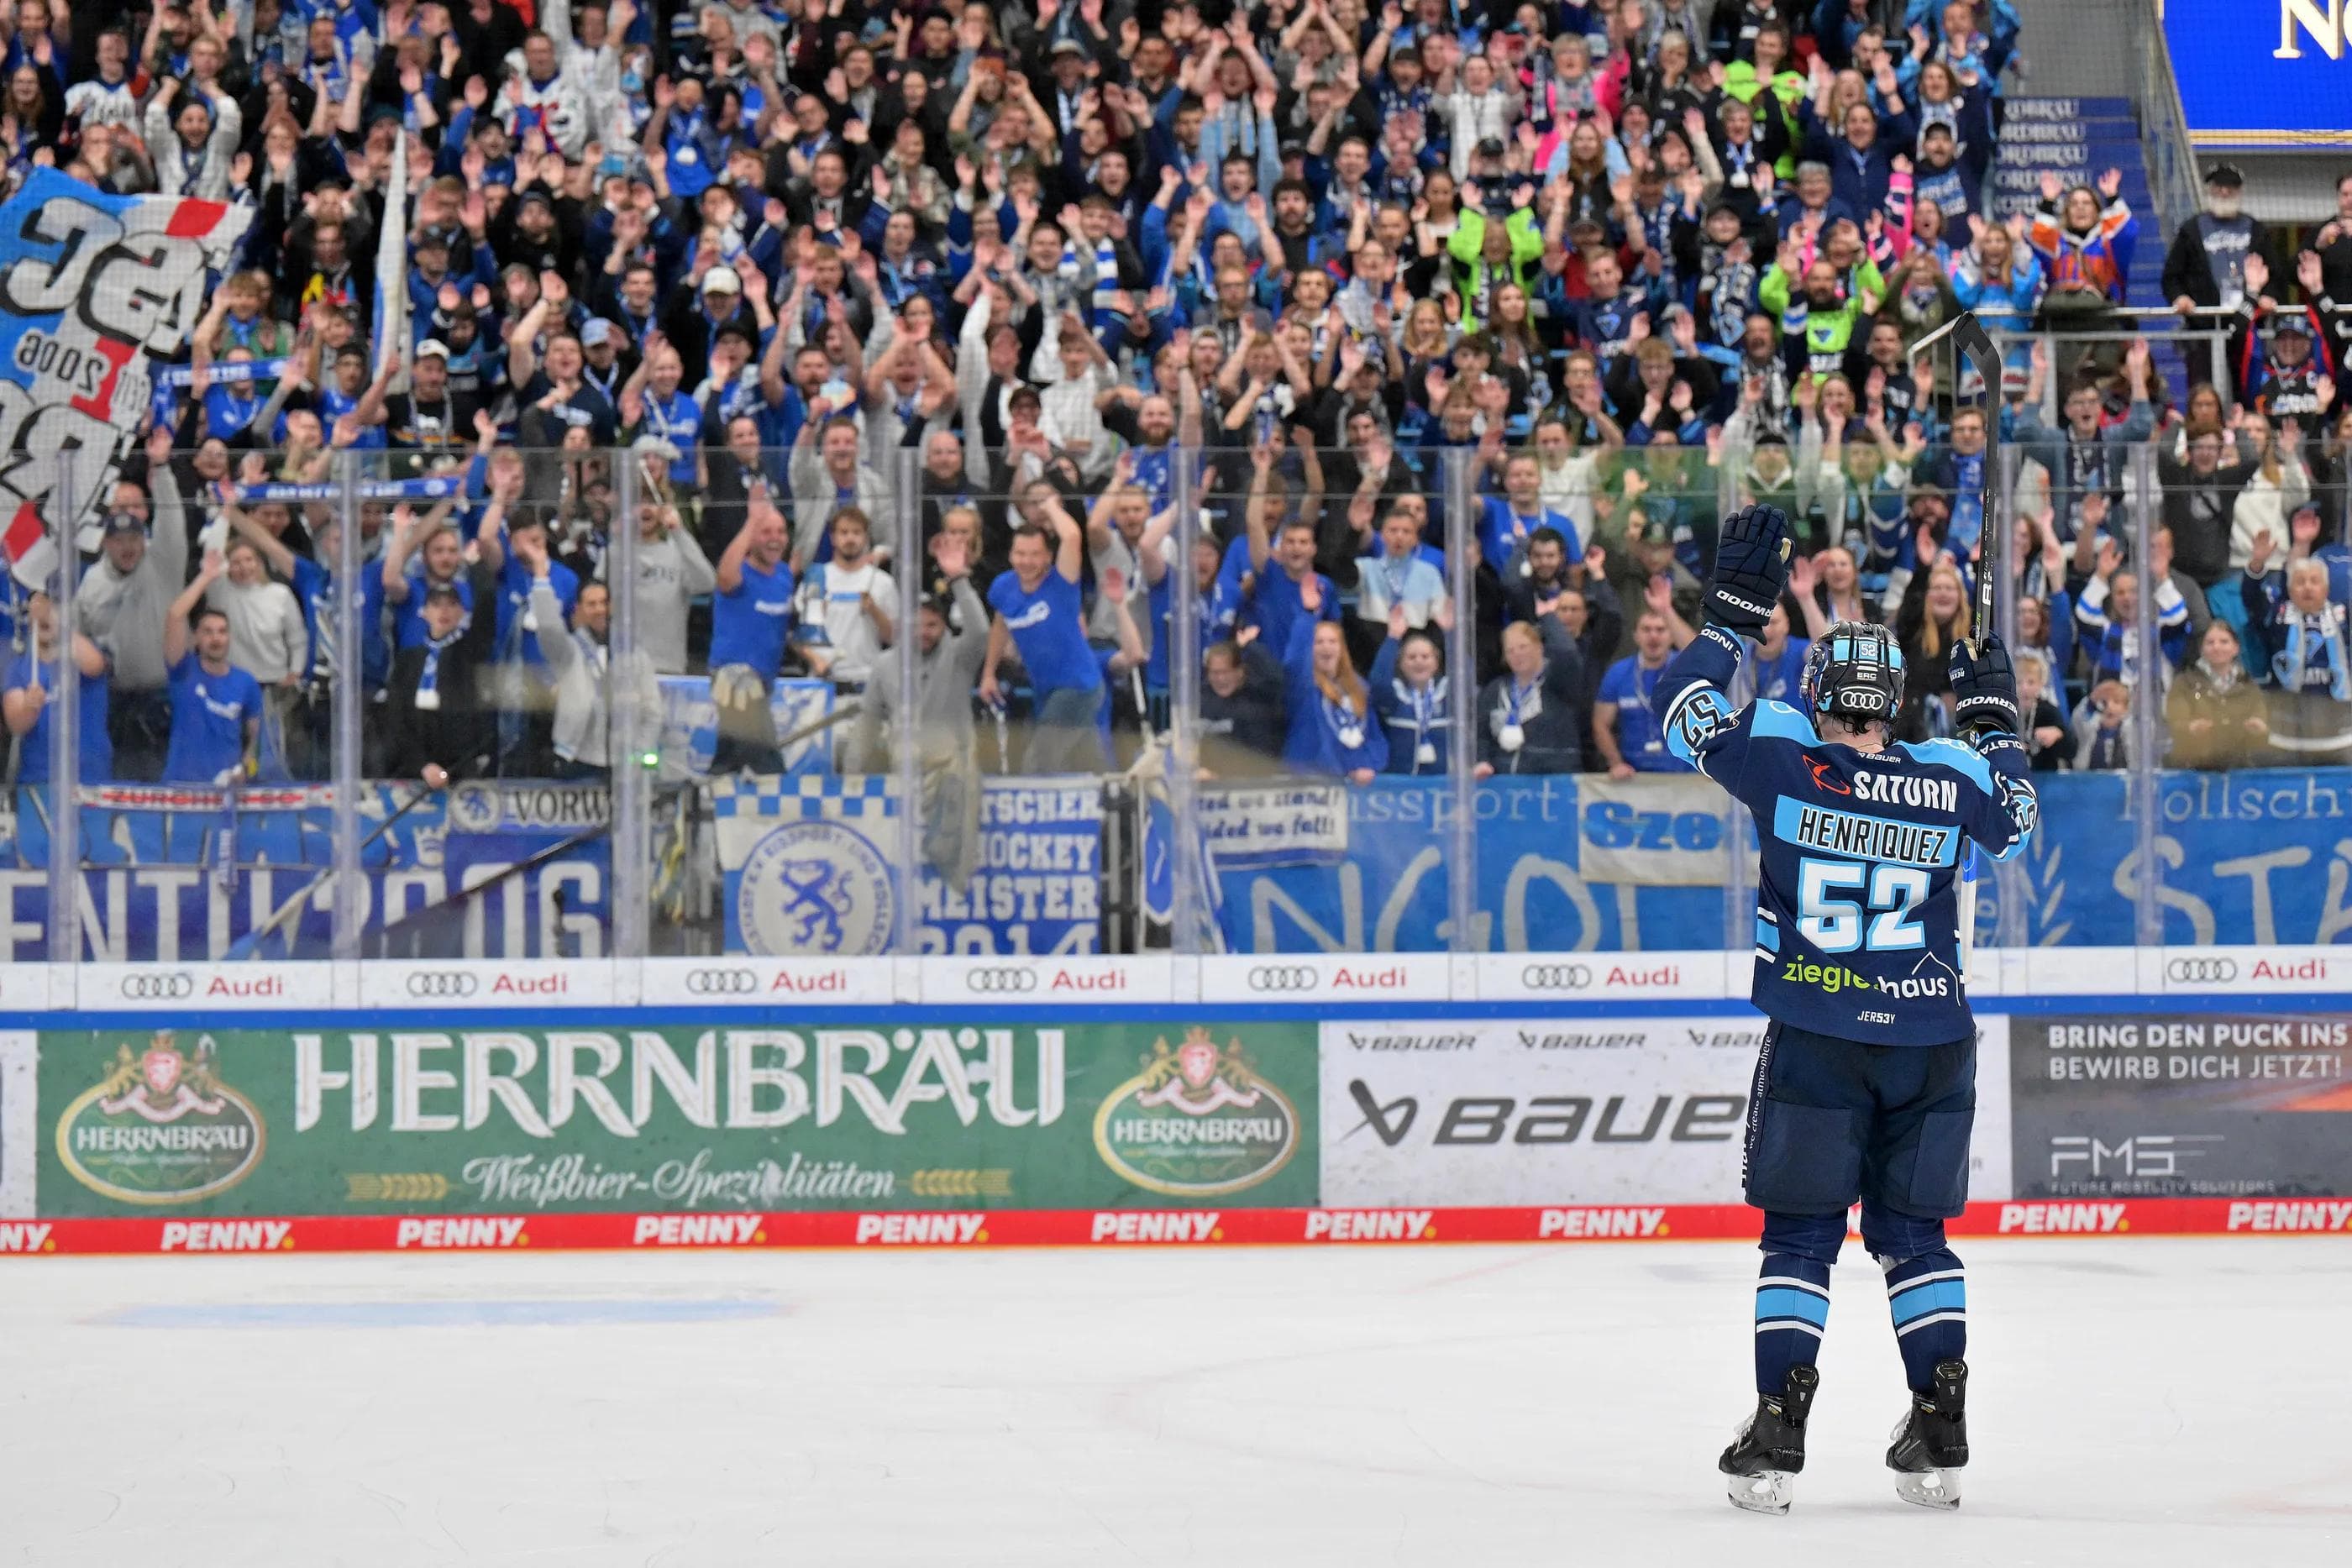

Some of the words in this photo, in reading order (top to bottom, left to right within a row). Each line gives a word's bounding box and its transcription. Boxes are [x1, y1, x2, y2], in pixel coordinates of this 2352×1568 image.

[2271, 0, 2352, 60] N
[1861, 643, 1876, 657] 52
[1856, 672, 1877, 681] ERC
[1853, 770, 1958, 813] SATURN
[1798, 805, 1950, 867] HENRIQUEZ
[914, 875, 1100, 921] MEISTER
[1796, 856, 1933, 954] 52
[772, 970, 847, 993] Audi
[1052, 968, 1126, 991] Audi
[1331, 967, 1407, 988] Audi
[1605, 965, 1680, 987] Audi
[2251, 959, 2327, 981] Audi
[207, 975, 284, 997] Audi
[491, 973, 570, 995] Audi
[2050, 1024, 2139, 1049] BRING
[2146, 1024, 2205, 1048] DEN
[2213, 1023, 2292, 1047] PUCK
[2301, 1022, 2348, 1046] INS
[1755, 1035, 1772, 1099] atmosphere
[2050, 1056, 2160, 1081] BEWIRB
[2168, 1055, 2240, 1080] DICH
[2248, 1054, 2342, 1079] JETZT!
[292, 1026, 1065, 1139] HERRNBRÄU
[1432, 1094, 1747, 1146] BAUE
[2050, 1135, 2176, 1177] FMS
